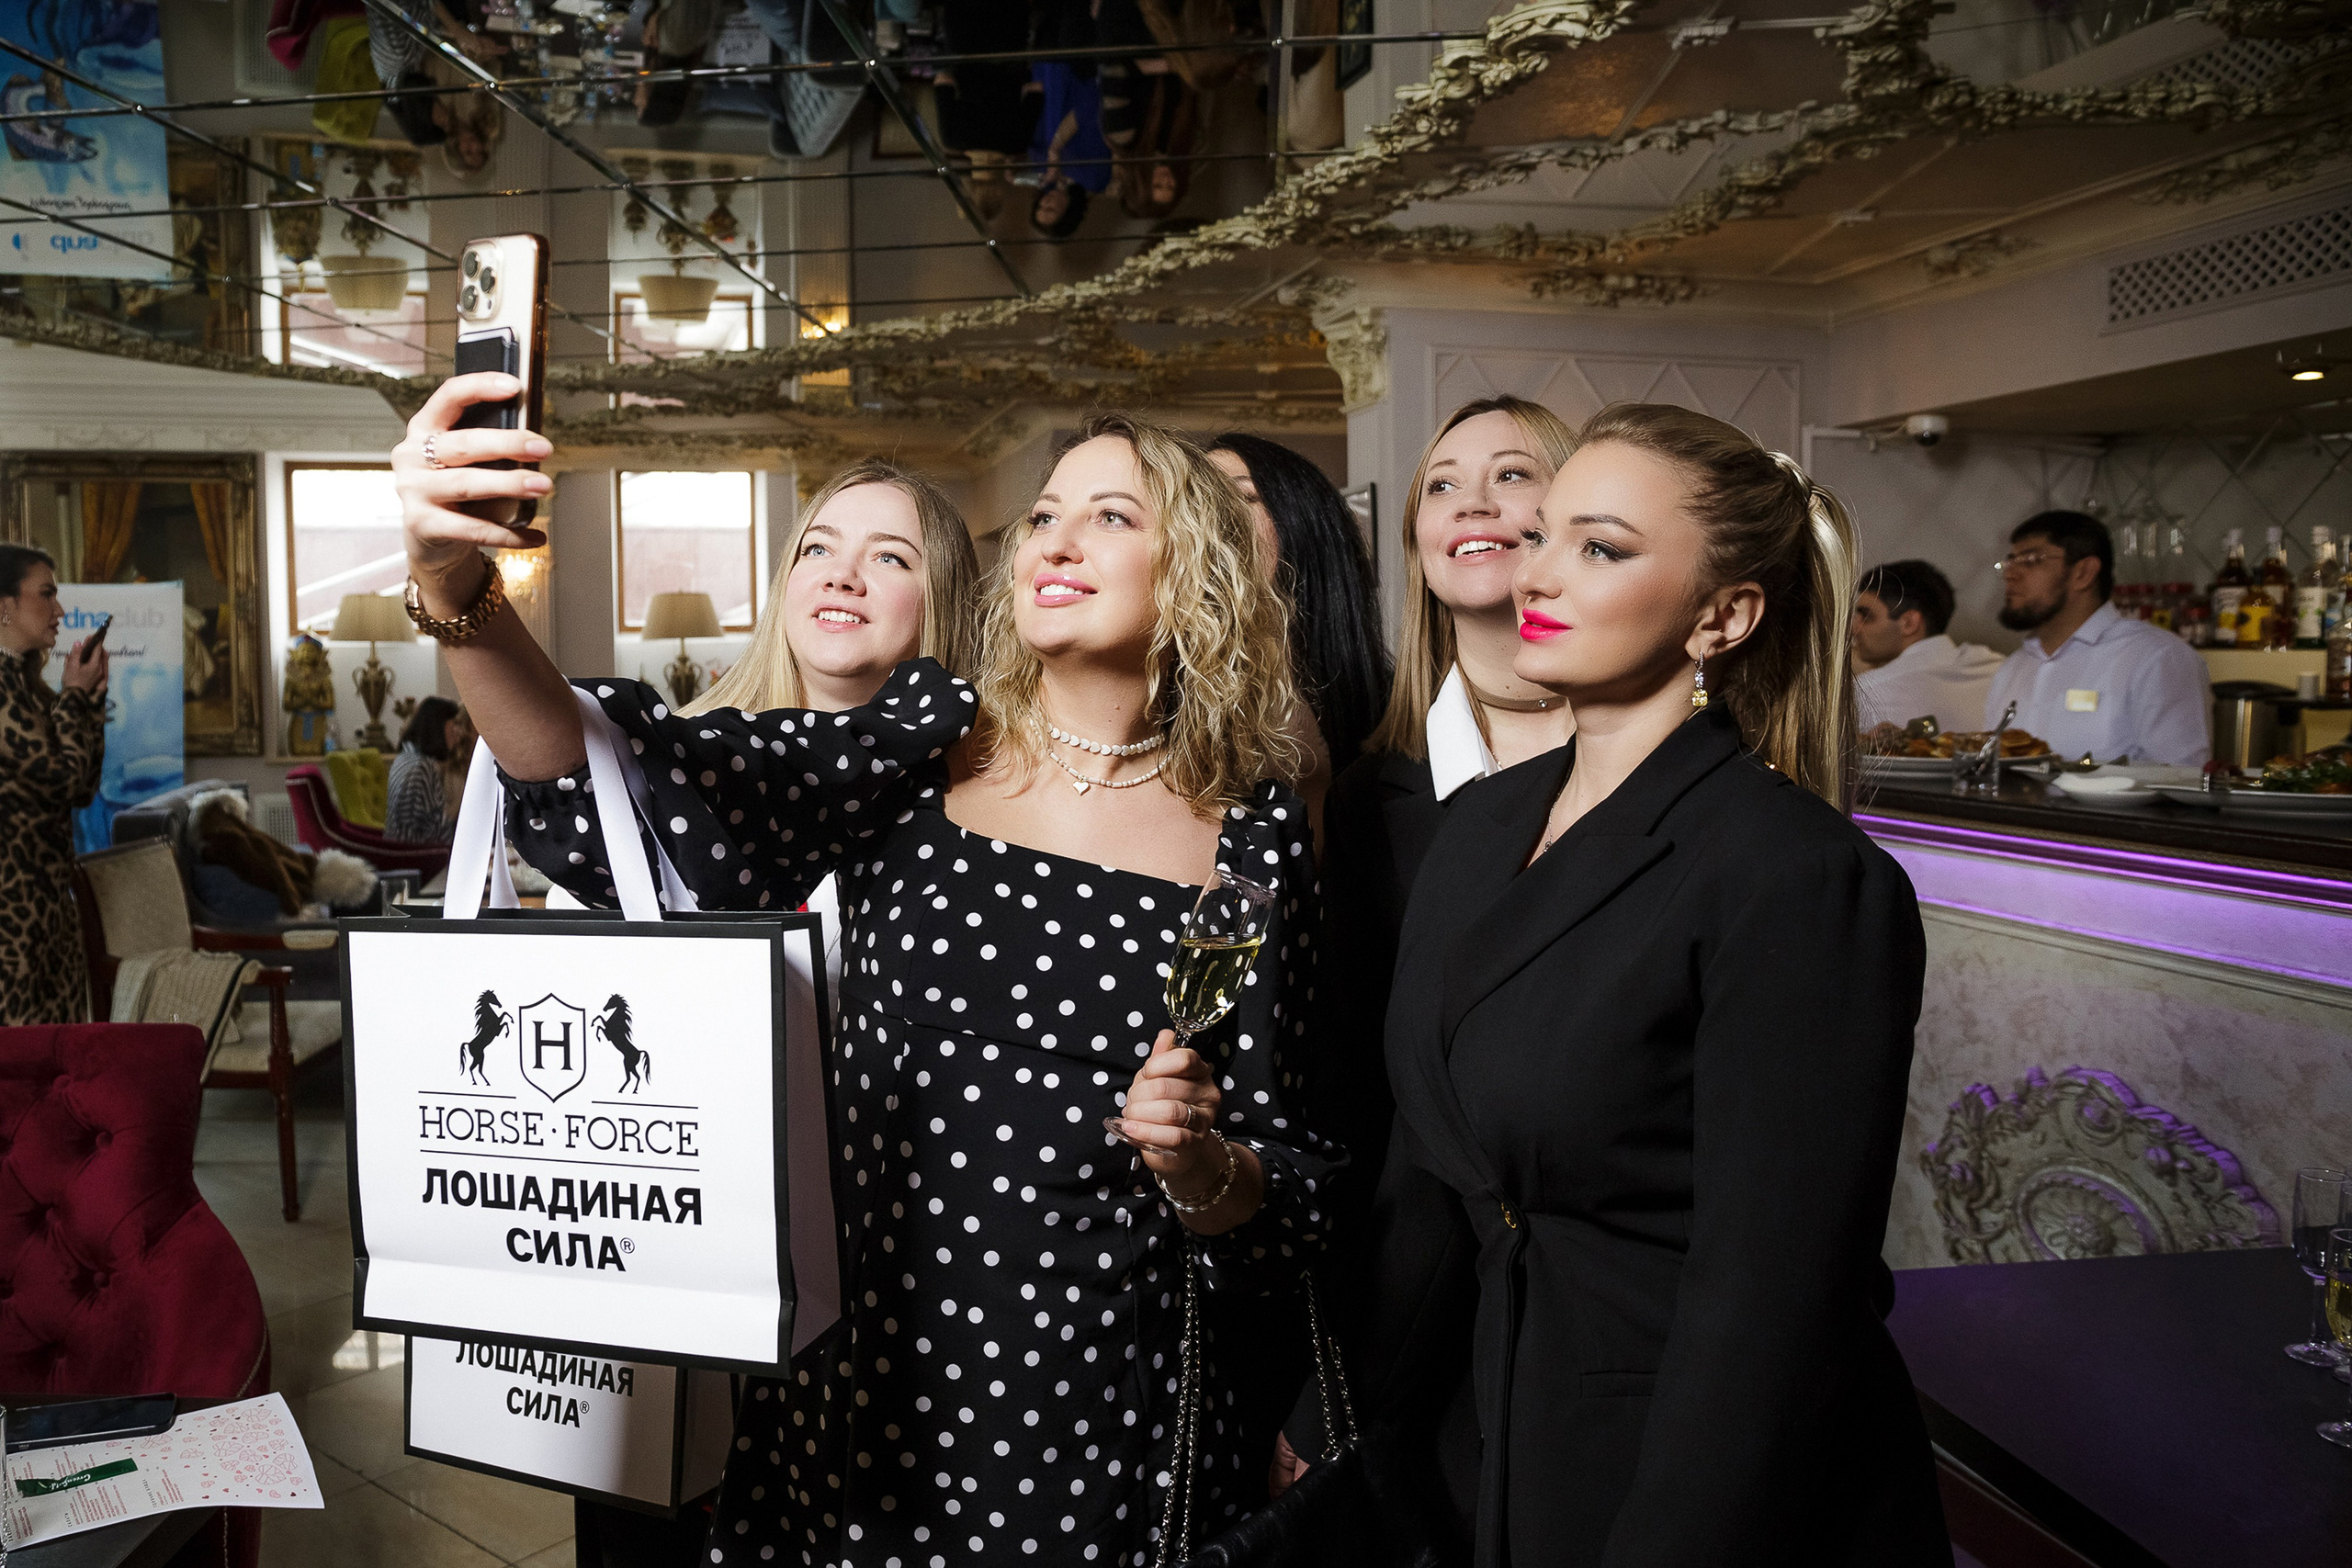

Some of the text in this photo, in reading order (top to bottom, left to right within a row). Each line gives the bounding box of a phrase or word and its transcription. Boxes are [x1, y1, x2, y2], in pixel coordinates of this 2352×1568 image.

[532, 1021, 573, 1071] H
[419, 1105, 699, 1157] HORSE FORCE
[422, 1168, 702, 1225] ЛОШАДИНАЯ
[456, 1340, 634, 1397] ЛОШАДИНАЯ
